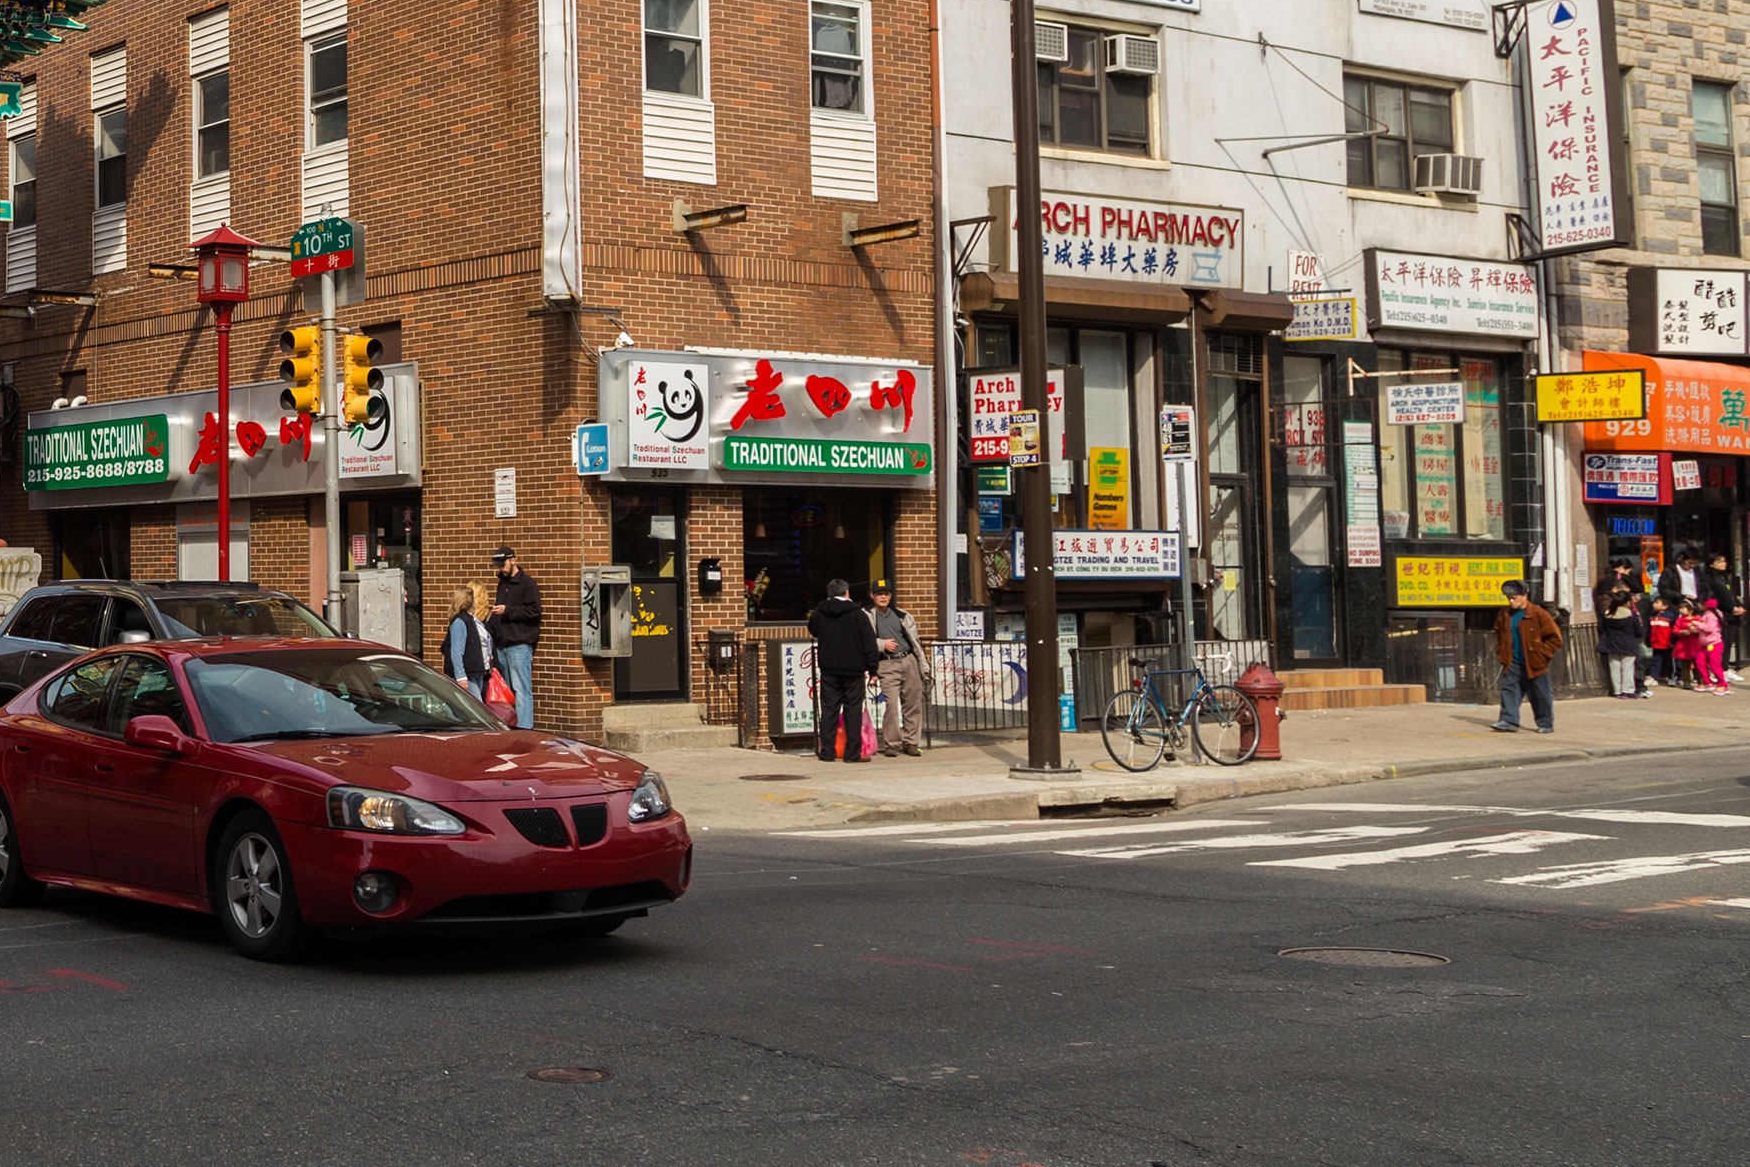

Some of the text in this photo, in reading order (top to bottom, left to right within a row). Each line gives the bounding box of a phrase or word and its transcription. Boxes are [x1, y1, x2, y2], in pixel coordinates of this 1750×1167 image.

[1540, 35, 1582, 198] 太平洋保險
[1577, 28, 1600, 193] PACIFIC INSURANCE
[1012, 201, 1241, 248] RCH PHARMACY
[337, 234, 350, 248] ST
[1547, 225, 1611, 245] 215-625-0340
[1295, 255, 1317, 277] FOR
[1381, 261, 1463, 289] 太平洋保險
[1292, 280, 1322, 301] RENT
[975, 377, 1016, 395] Arch
[1554, 374, 1626, 395] 鄭浩坤
[975, 394, 1063, 414] Pharcy
[1390, 397, 1461, 407] ARCH ACUPUNCTURE
[1396, 405, 1456, 414] HEALTH CENTER
[1013, 414, 1034, 423] TOUR
[1161, 423, 1173, 433] 48
[1606, 420, 1651, 436] 929
[27, 421, 145, 465] TRADITIONAL SZECHUAN
[1163, 434, 1173, 444] 61
[634, 444, 705, 456] Traditional Szechuan
[731, 441, 905, 470] TRADITIONAL SZECHUAN
[633, 454, 687, 464] Restaurant LLC
[1013, 454, 1037, 464] STOP 4
[1606, 456, 1658, 465] Trans-Fast
[27, 458, 164, 484] 215-925-8688/8788
[370, 464, 380, 472] LLC
[1093, 493, 1124, 502] Numbers
[1093, 502, 1117, 511] Games
[1055, 537, 1160, 554] 江旅遊貿易公司
[1053, 556, 1160, 564] GTZE TRADING AND TRAVEL
[956, 629, 983, 638] ANGTZE
